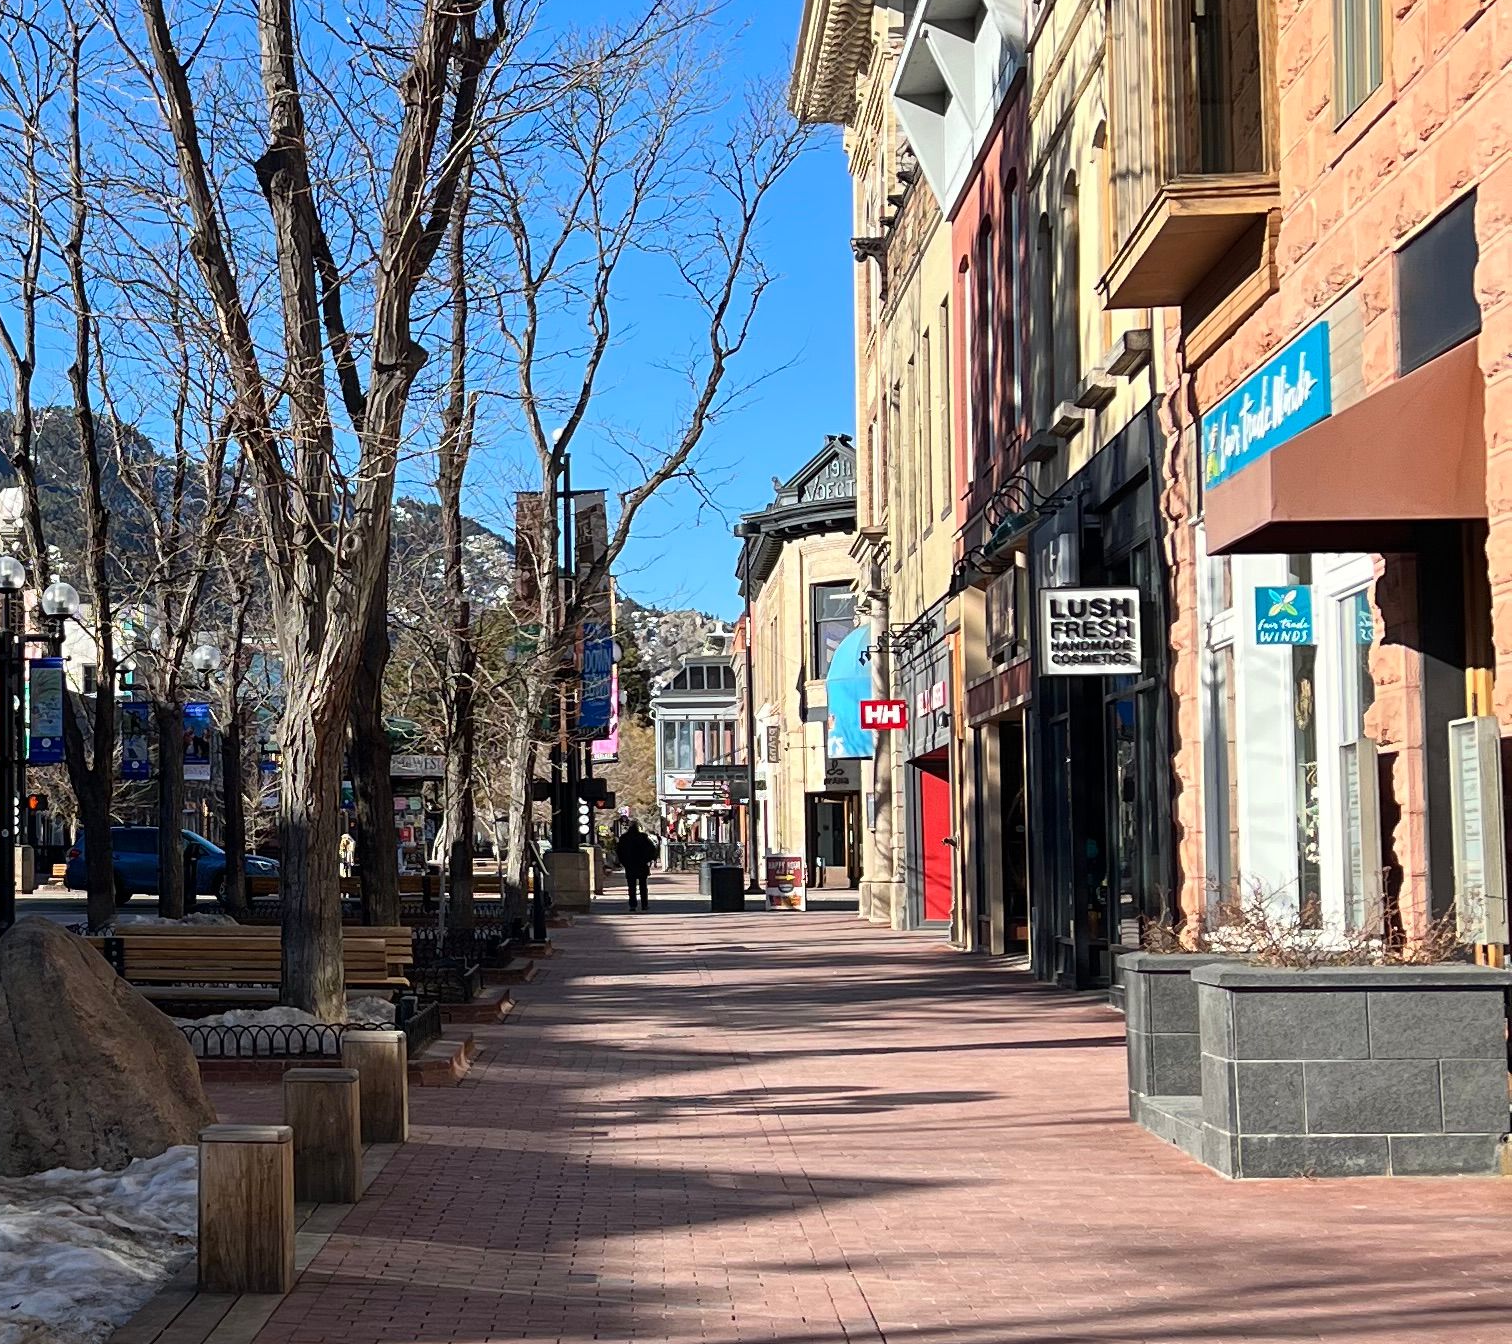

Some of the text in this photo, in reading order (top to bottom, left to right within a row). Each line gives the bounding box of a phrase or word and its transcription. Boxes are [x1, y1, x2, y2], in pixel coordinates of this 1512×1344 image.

[825, 458, 852, 477] 1911
[1050, 597, 1133, 619] LUSH
[1050, 619, 1133, 639] FRESH
[1260, 629, 1308, 643] WINDS
[1050, 639, 1134, 652] HANDMADE
[1051, 652, 1134, 666] COSMETICS
[865, 704, 901, 724] HH
